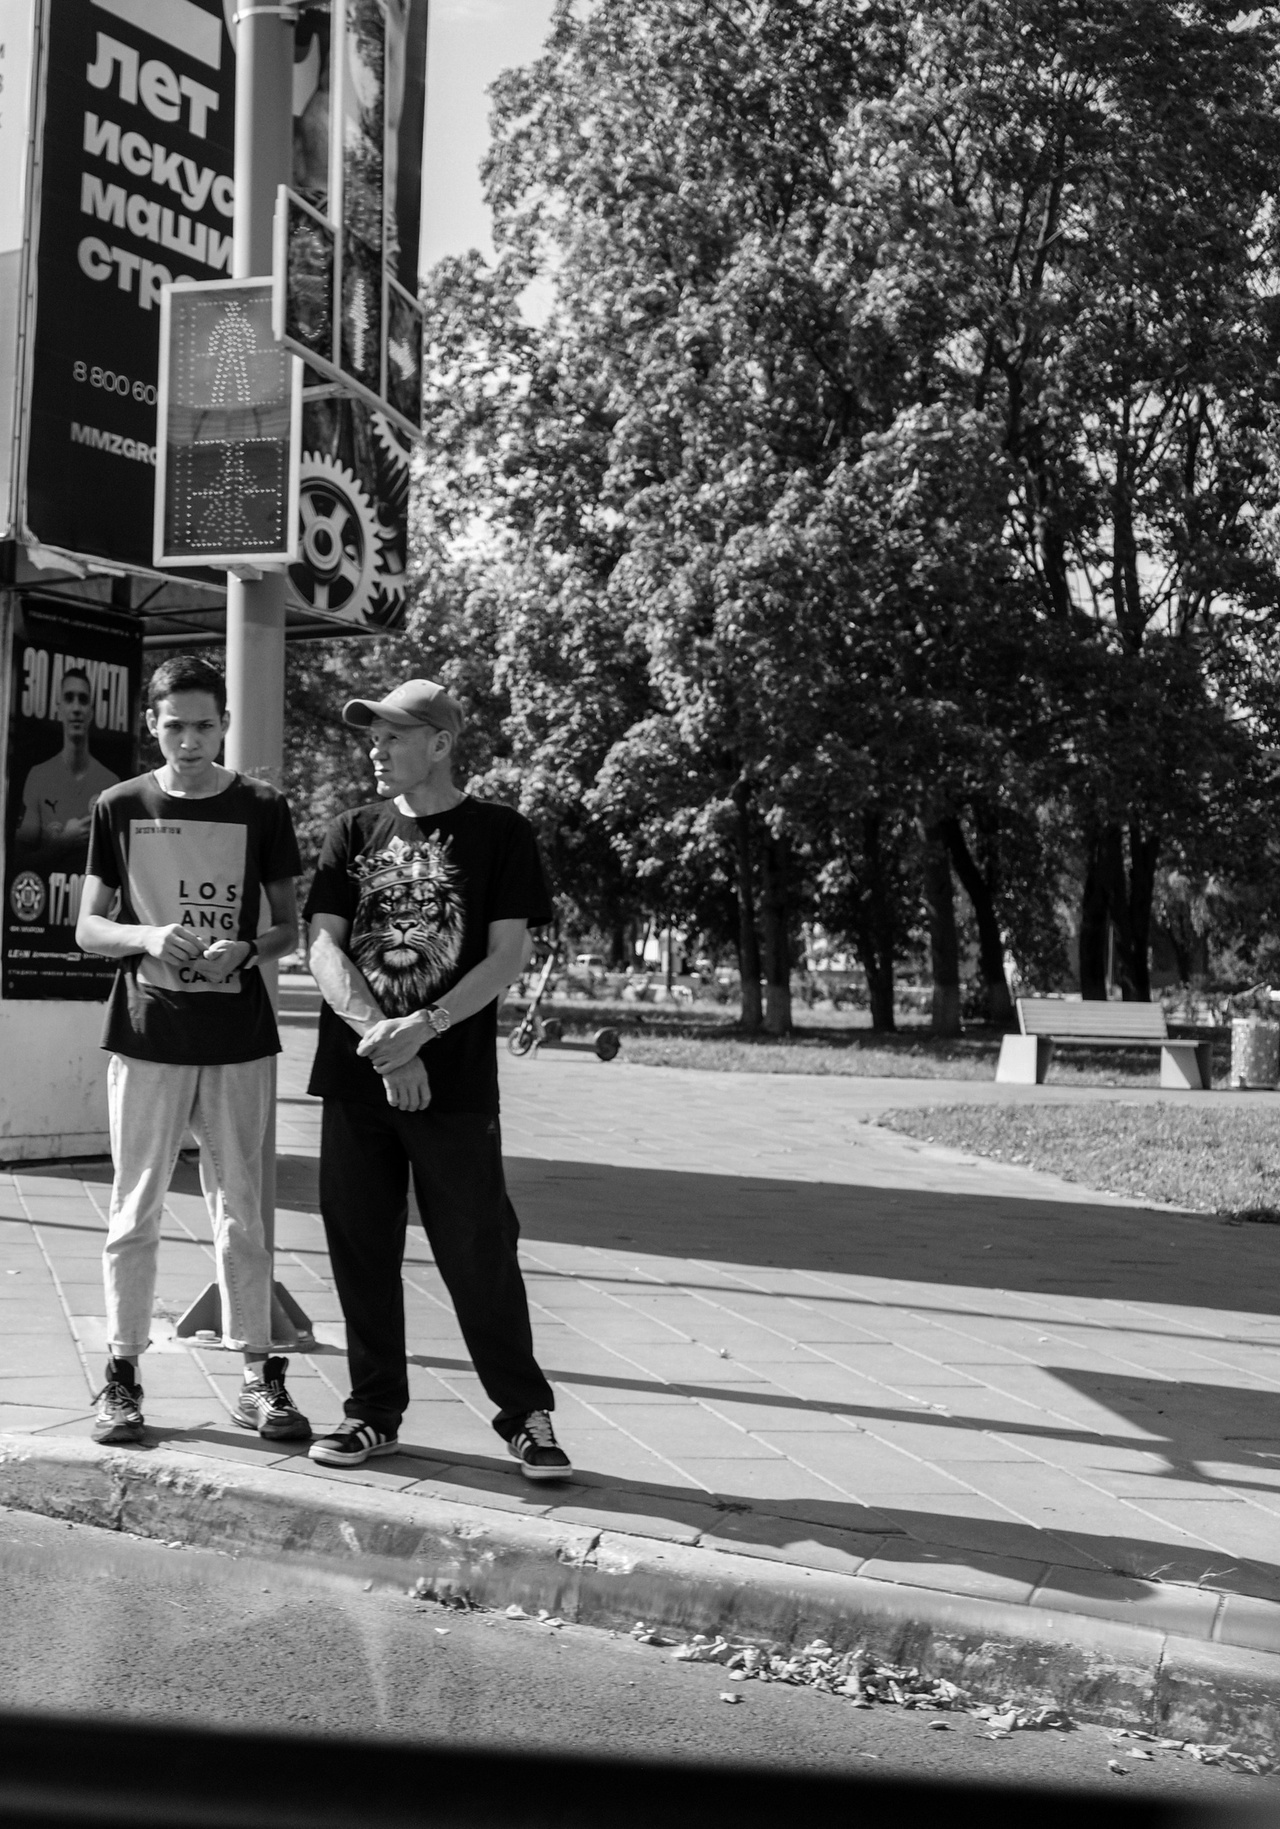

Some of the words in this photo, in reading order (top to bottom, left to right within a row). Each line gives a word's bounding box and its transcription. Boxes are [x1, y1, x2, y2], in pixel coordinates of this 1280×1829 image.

[86, 30, 219, 140] лет
[77, 236, 198, 311] стр
[72, 360, 88, 382] 8
[89, 366, 131, 396] 800
[132, 380, 158, 406] 60
[22, 646, 49, 719] 30
[49, 652, 129, 733] АУСТА
[179, 880, 237, 902] LOS
[181, 910, 234, 930] ANG
